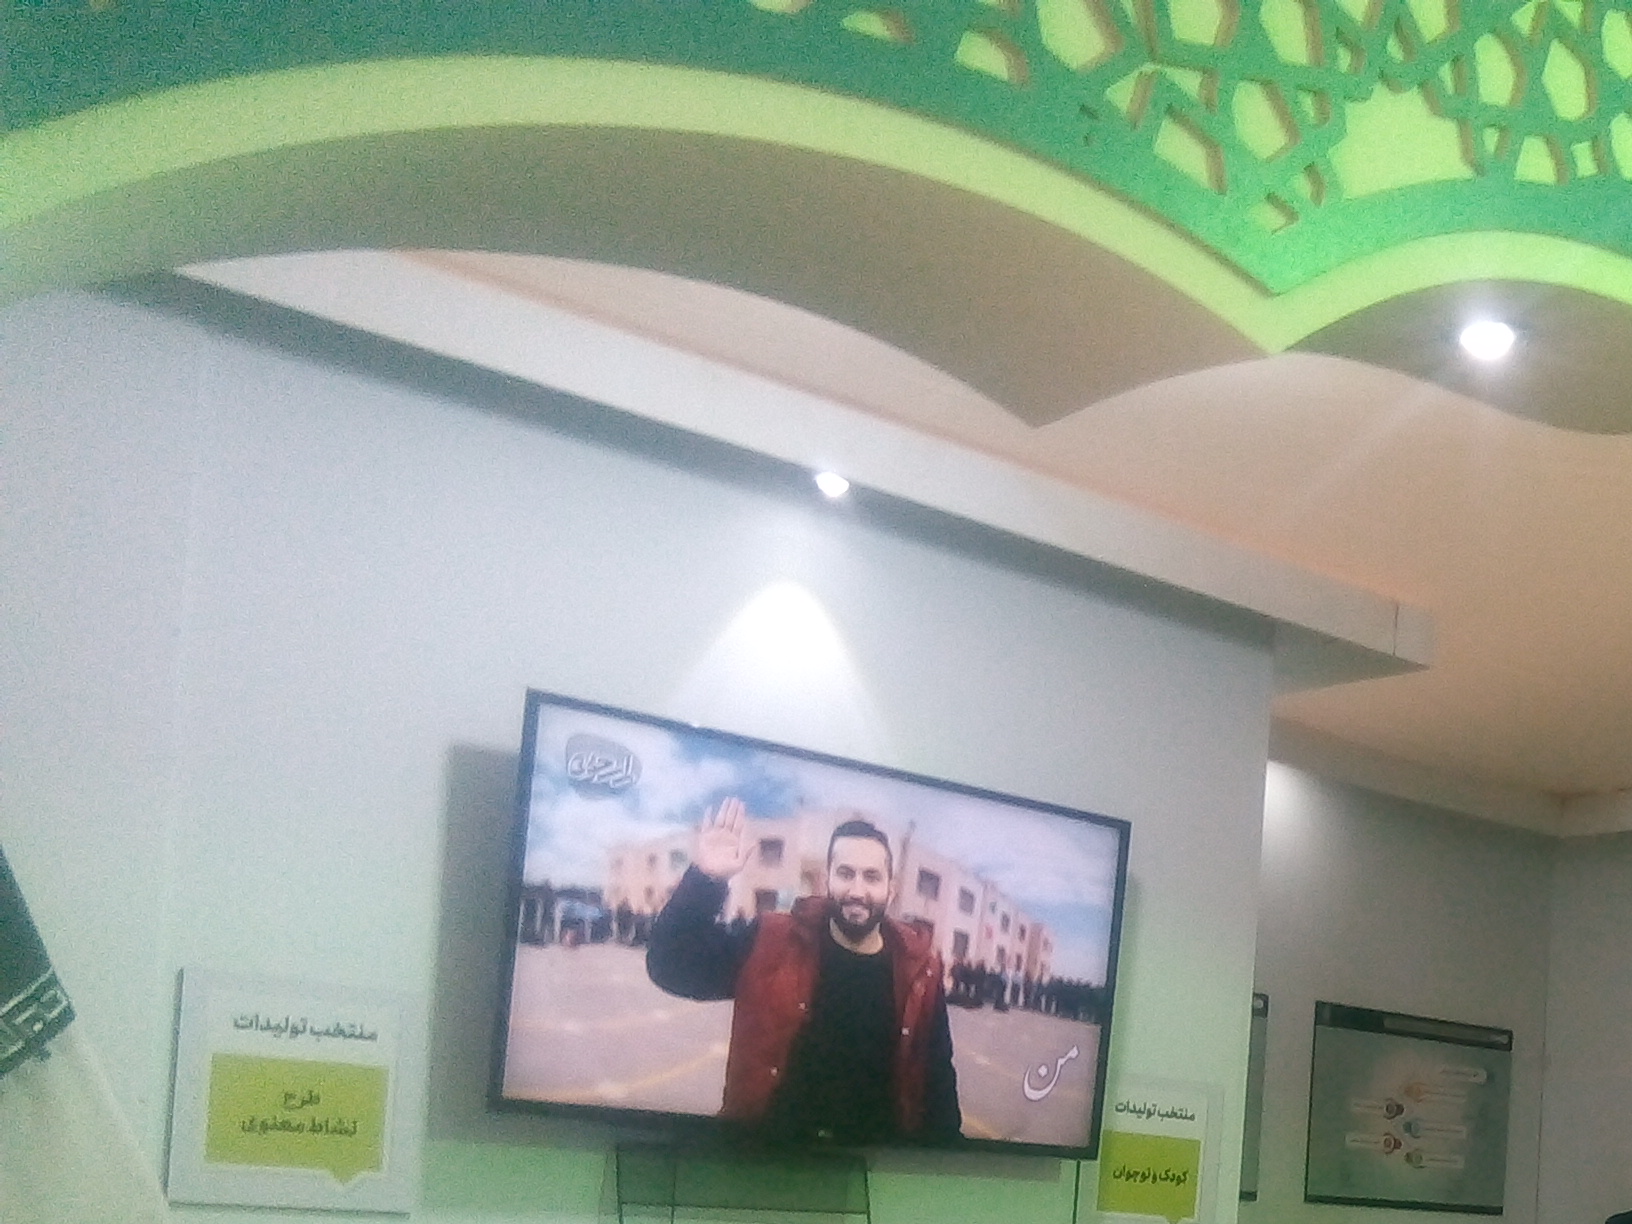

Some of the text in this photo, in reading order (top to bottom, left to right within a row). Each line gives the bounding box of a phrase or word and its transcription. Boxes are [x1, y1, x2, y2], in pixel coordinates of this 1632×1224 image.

[234, 1013, 378, 1042] منتخب تولیدات
[1024, 1045, 1079, 1101] من
[283, 1089, 320, 1111] طرح
[1115, 1100, 1196, 1121] منتخب تولیدات
[309, 1117, 358, 1137] نشاط
[1113, 1165, 1151, 1183] نوجوان
[1159, 1168, 1190, 1187] کودک
